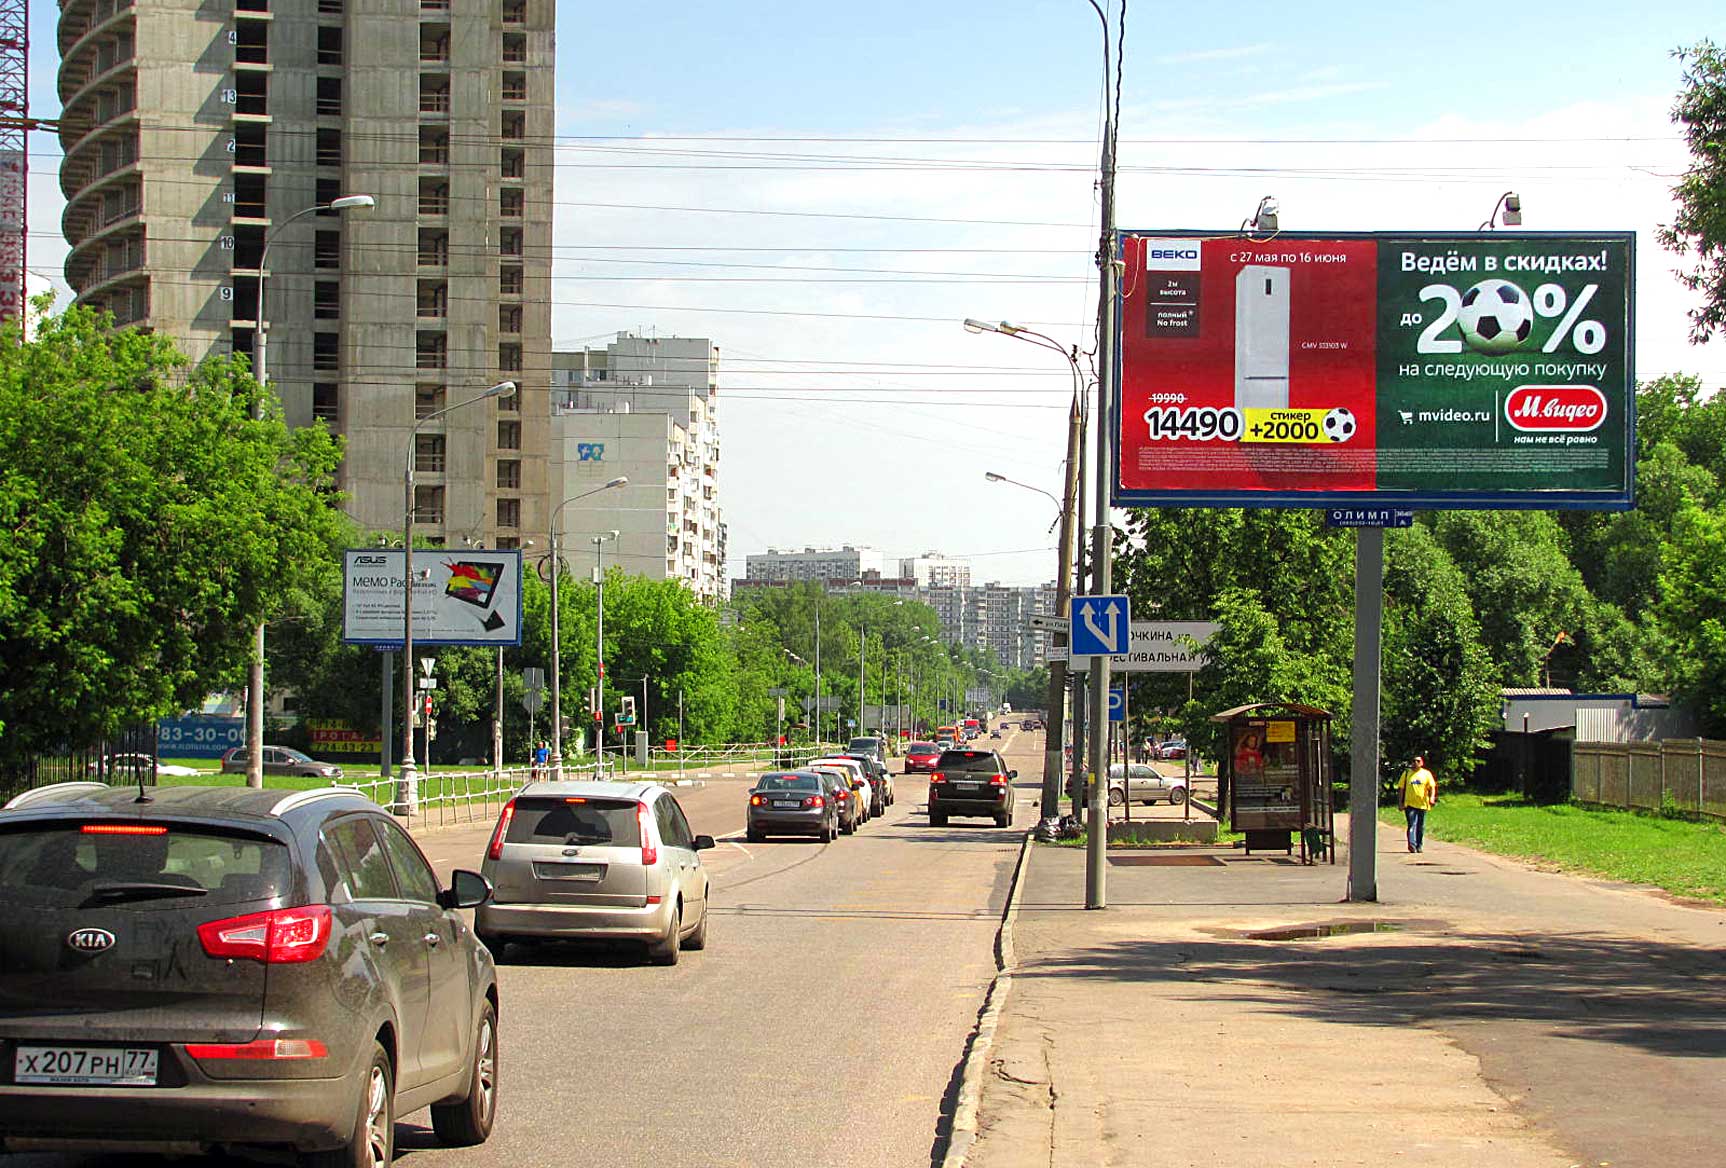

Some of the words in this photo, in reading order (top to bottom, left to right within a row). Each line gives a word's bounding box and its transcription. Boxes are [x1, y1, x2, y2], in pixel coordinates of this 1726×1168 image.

[222, 90, 236, 103] 13
[222, 237, 234, 248] 10
[1151, 250, 1197, 259] BEKO
[1230, 253, 1237, 262] с
[1240, 252, 1252, 262] 27
[1255, 254, 1278, 262] мая
[1281, 254, 1296, 262] по
[1299, 252, 1312, 262] 16
[1314, 254, 1347, 262] июня
[1401, 250, 1477, 274] Ведём
[1484, 256, 1498, 271] в
[1504, 250, 1608, 274] скидках!
[222, 287, 232, 300] 9
[1157, 319, 1168, 327] No
[1170, 319, 1188, 327] frost
[1400, 313, 1422, 326] до
[1417, 279, 1606, 356] 20%
[1399, 364, 1419, 376] на
[1424, 363, 1530, 381] следующую
[1535, 363, 1607, 381] покупку
[1151, 393, 1185, 403] 19990
[1418, 408, 1490, 422] mvideo.ru
[1513, 395, 1598, 423] М.видео
[1270, 412, 1311, 421] стикер
[1147, 410, 1239, 437] 14490
[1250, 421, 1319, 439] +2000
[1513, 436, 1534, 444] нам
[1535, 436, 1547, 444] не
[1548, 434, 1566, 444] всё
[1566, 436, 1598, 447] равно
[1332, 510, 1389, 520] ОЛИМП
[354, 556, 387, 564] ASUS
[353, 576, 388, 588] MeMO
[1110, 652, 1196, 663] ЕСТИВАЛЬНАЯ
[75, 933, 107, 947] KIA
[127, 1051, 150, 1069] 77
